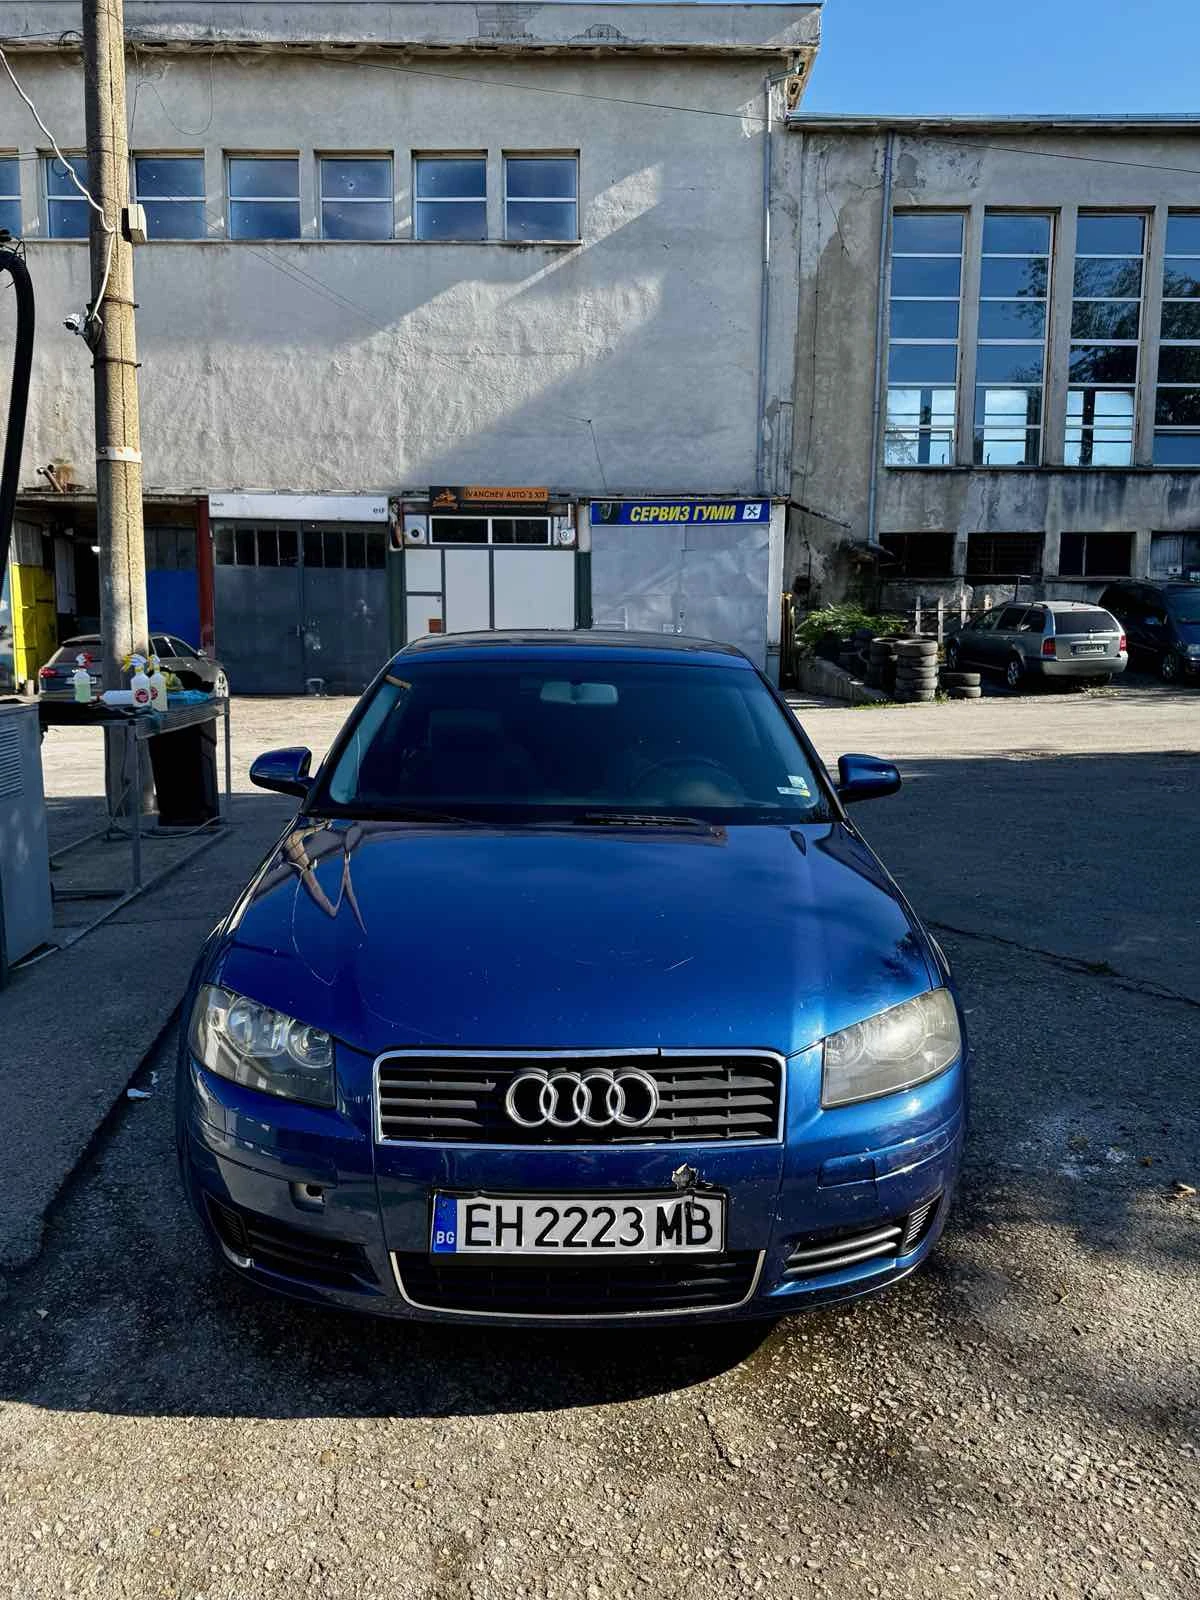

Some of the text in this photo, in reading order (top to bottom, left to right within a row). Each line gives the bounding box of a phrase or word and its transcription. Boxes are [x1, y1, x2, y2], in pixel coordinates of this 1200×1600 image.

[630, 505, 736, 522] СЕРВИЗ ГУМИ
[465, 1201, 713, 1248] EH 2223 MB
[436, 1231, 455, 1245] BG
